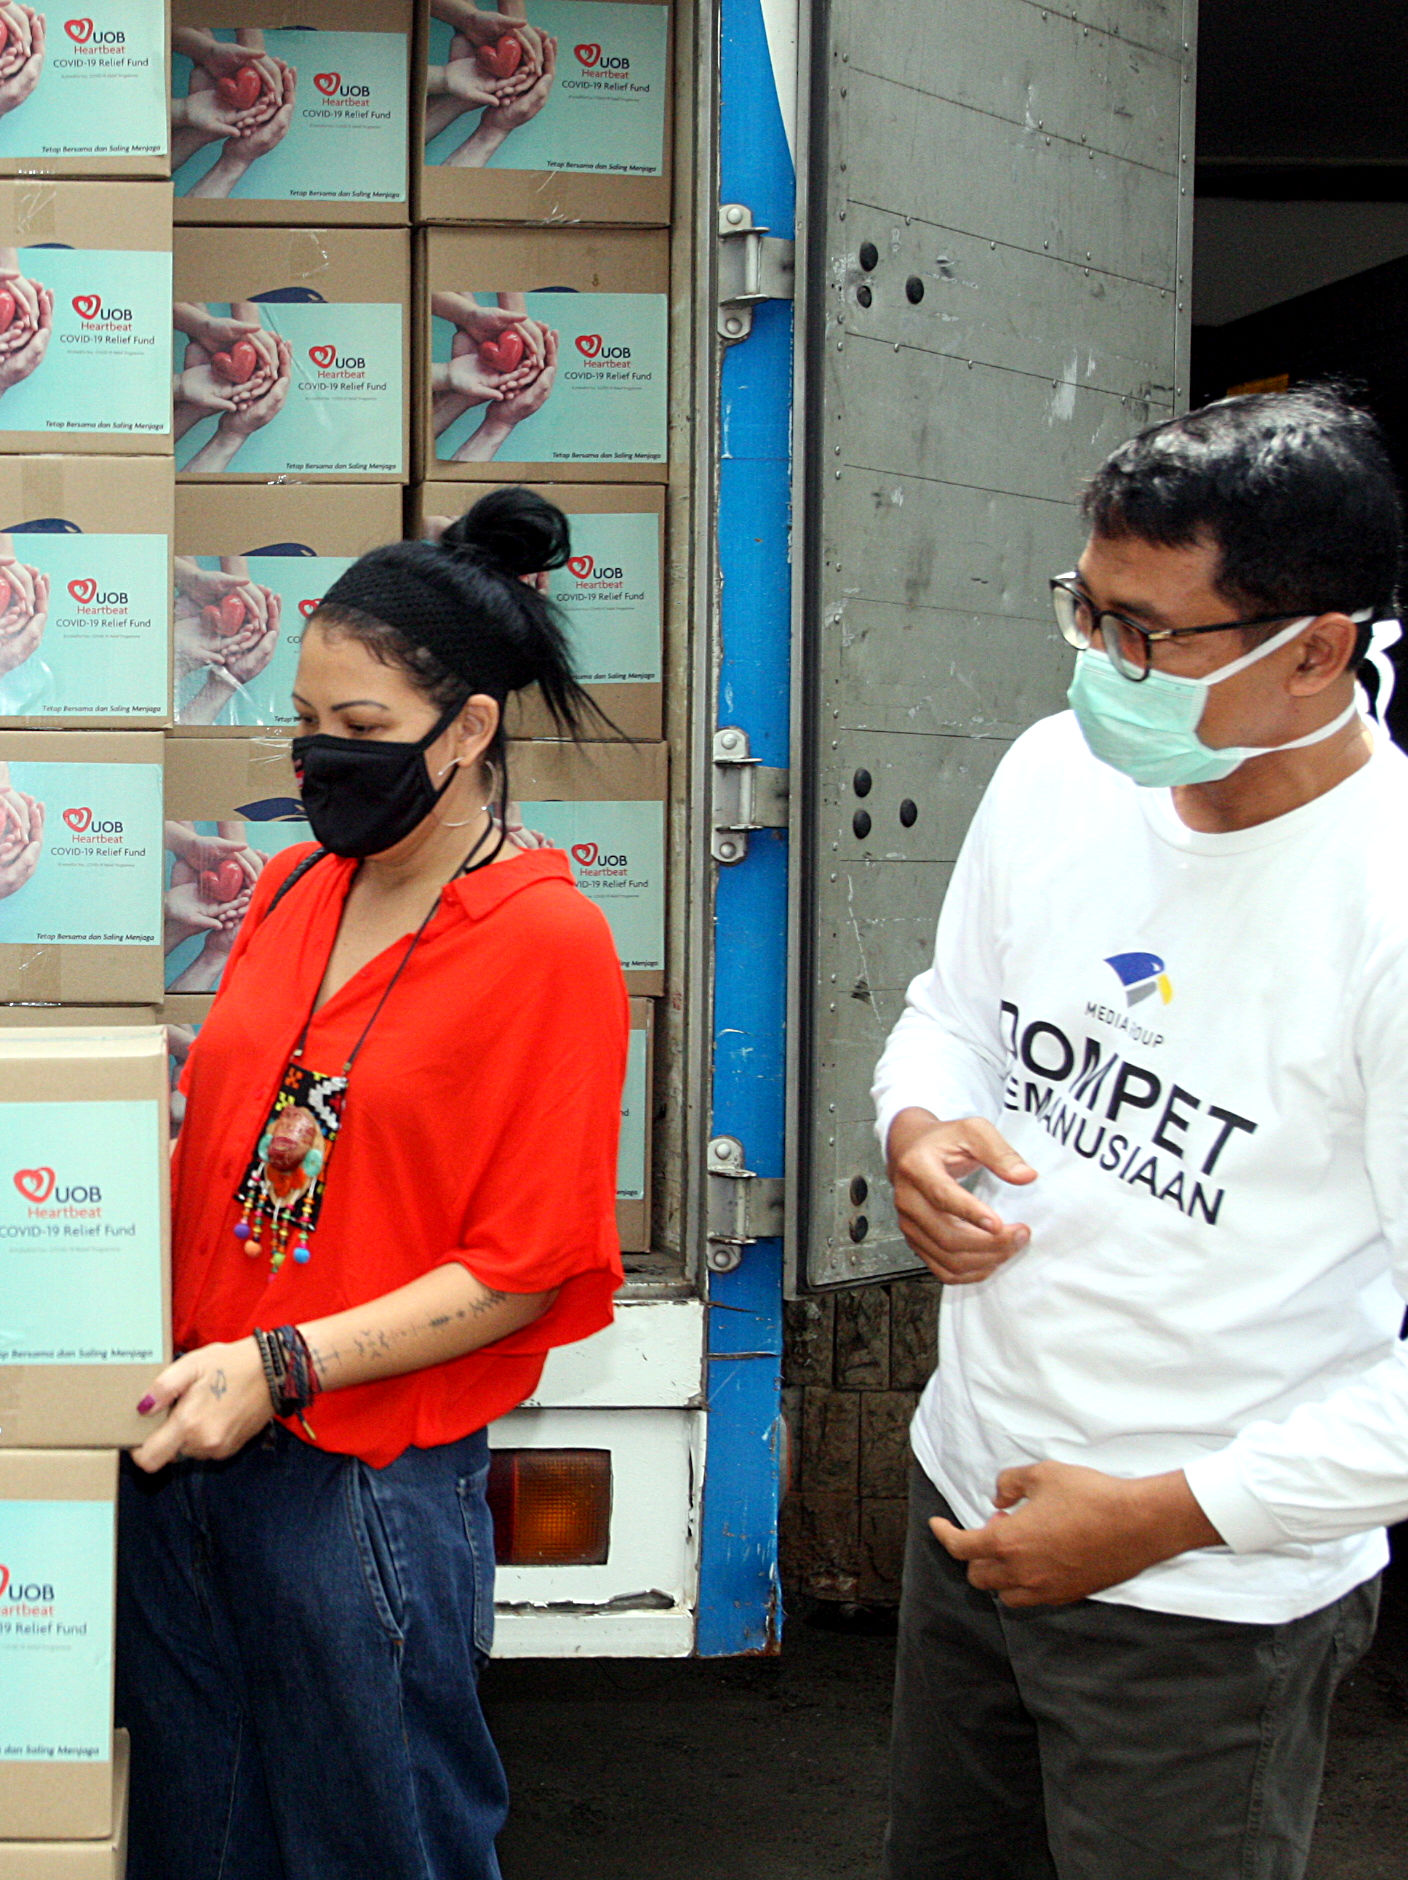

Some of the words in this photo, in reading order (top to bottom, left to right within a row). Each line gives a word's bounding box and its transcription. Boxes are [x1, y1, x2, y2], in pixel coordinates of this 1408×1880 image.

[92, 31, 125, 43] UOB
[74, 45, 126, 55] Heartbeat
[52, 58, 96, 68] COVID-19
[98, 58, 125, 67] Relief
[126, 58, 149, 67] Fund
[600, 57, 630, 69] UOB
[582, 68, 629, 79] Heartbeat
[340, 85, 370, 97] UOB
[561, 80, 602, 90] COVID-19
[603, 82, 628, 91] Relief
[630, 83, 650, 92] Fund
[322, 97, 370, 107] Heartbeat
[302, 109, 342, 118] COVID-19
[344, 110, 369, 119] Relief
[370, 111, 391, 119] Fund
[100, 308, 133, 321] UOB
[81, 321, 132, 332] Heartbeat
[59, 334, 103, 344] COVID-19
[105, 335, 131, 344] Relief
[133, 336, 155, 345] Fund
[601, 347, 631, 358] UOB
[335, 358, 365, 368] UOB
[583, 359, 631, 368] Heartbeat
[318, 370, 365, 379] Heartbeat
[564, 372, 604, 380] COVID-19
[606, 372, 630, 380] Relief
[632, 372, 652, 380] Fund
[298, 382, 338, 390] COVID-19
[340, 382, 365, 391] Relief
[366, 382, 387, 390] Fund
[593, 567, 623, 579] UOB
[575, 580, 623, 590] Heartbeat
[96, 592, 128, 604] UOB
[556, 593, 596, 602] COVID-19
[598, 592, 623, 601] Relief
[624, 592, 644, 600] Fund
[77, 606, 128, 615] Heartbeat
[55, 619, 99, 627] COVID-19
[101, 619, 127, 628] Relief
[129, 619, 151, 628] Fund
[91, 821, 123, 833] UOB
[72, 834, 123, 844] Heartbeat
[50, 847, 94, 856] COVID-19
[95, 847, 122, 856] Relief
[124, 848, 146, 857] Fund
[597, 855, 627, 866] UOB
[580, 868, 627, 877] Heartbeat
[602, 880, 627, 888] Relief
[628, 880, 649, 888] Fund
[54, 1186, 102, 1203] UOB
[27, 1205, 102, 1219] Heartbeat
[63, 1224, 101, 1237] Relief
[104, 1224, 136, 1237] Fund
[8, 1584, 55, 1601] UOB
[15, 1622, 53, 1635] Relief
[56, 1623, 88, 1635] Fund
